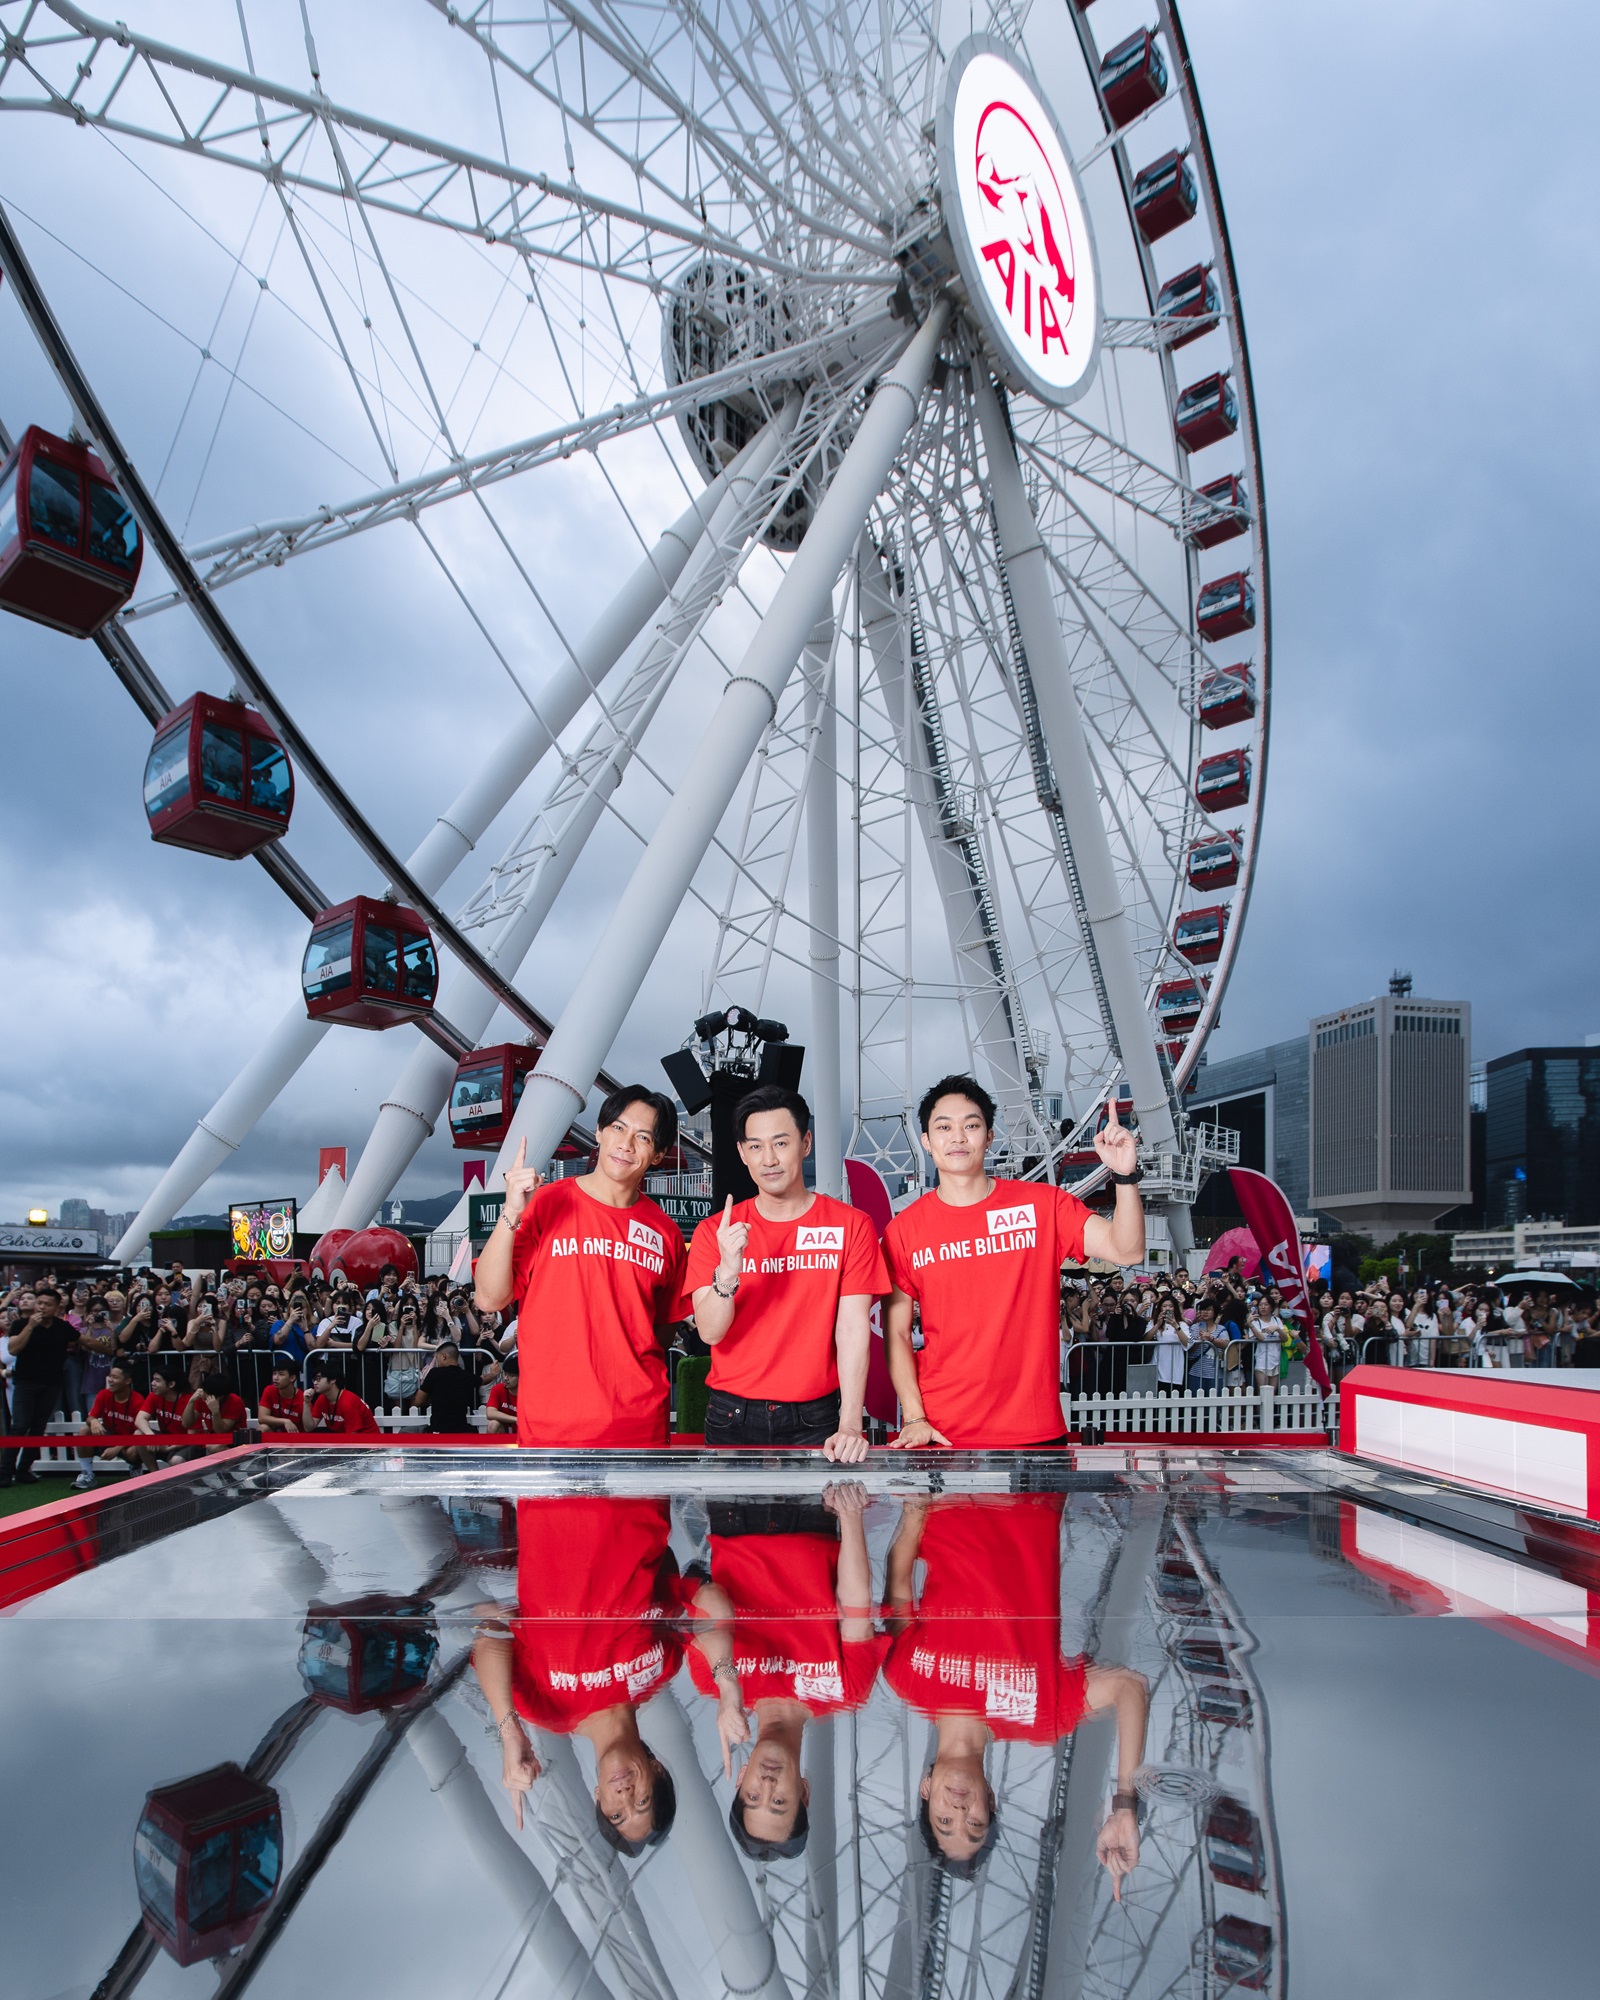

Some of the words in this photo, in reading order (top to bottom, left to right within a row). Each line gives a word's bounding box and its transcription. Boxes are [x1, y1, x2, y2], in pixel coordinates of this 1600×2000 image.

[981, 239, 1069, 355] AIA
[160, 772, 173, 790] AIA
[320, 965, 334, 980] AIA
[469, 1105, 483, 1116] AIA
[480, 1203, 504, 1222] MIL
[660, 1198, 688, 1216] MILK
[690, 1200, 712, 1217] TOP
[993, 1210, 1030, 1229] AIA
[0, 1235, 30, 1247] Color
[32, 1236, 71, 1249] Chacha
[552, 1238, 578, 1257] AIA
[633, 1227, 659, 1249] AIA
[801, 1231, 838, 1245] AIA
[740, 1257, 757, 1273] IA
[912, 1247, 936, 1270] AIA
[1268, 1239, 1308, 1318] AIA
